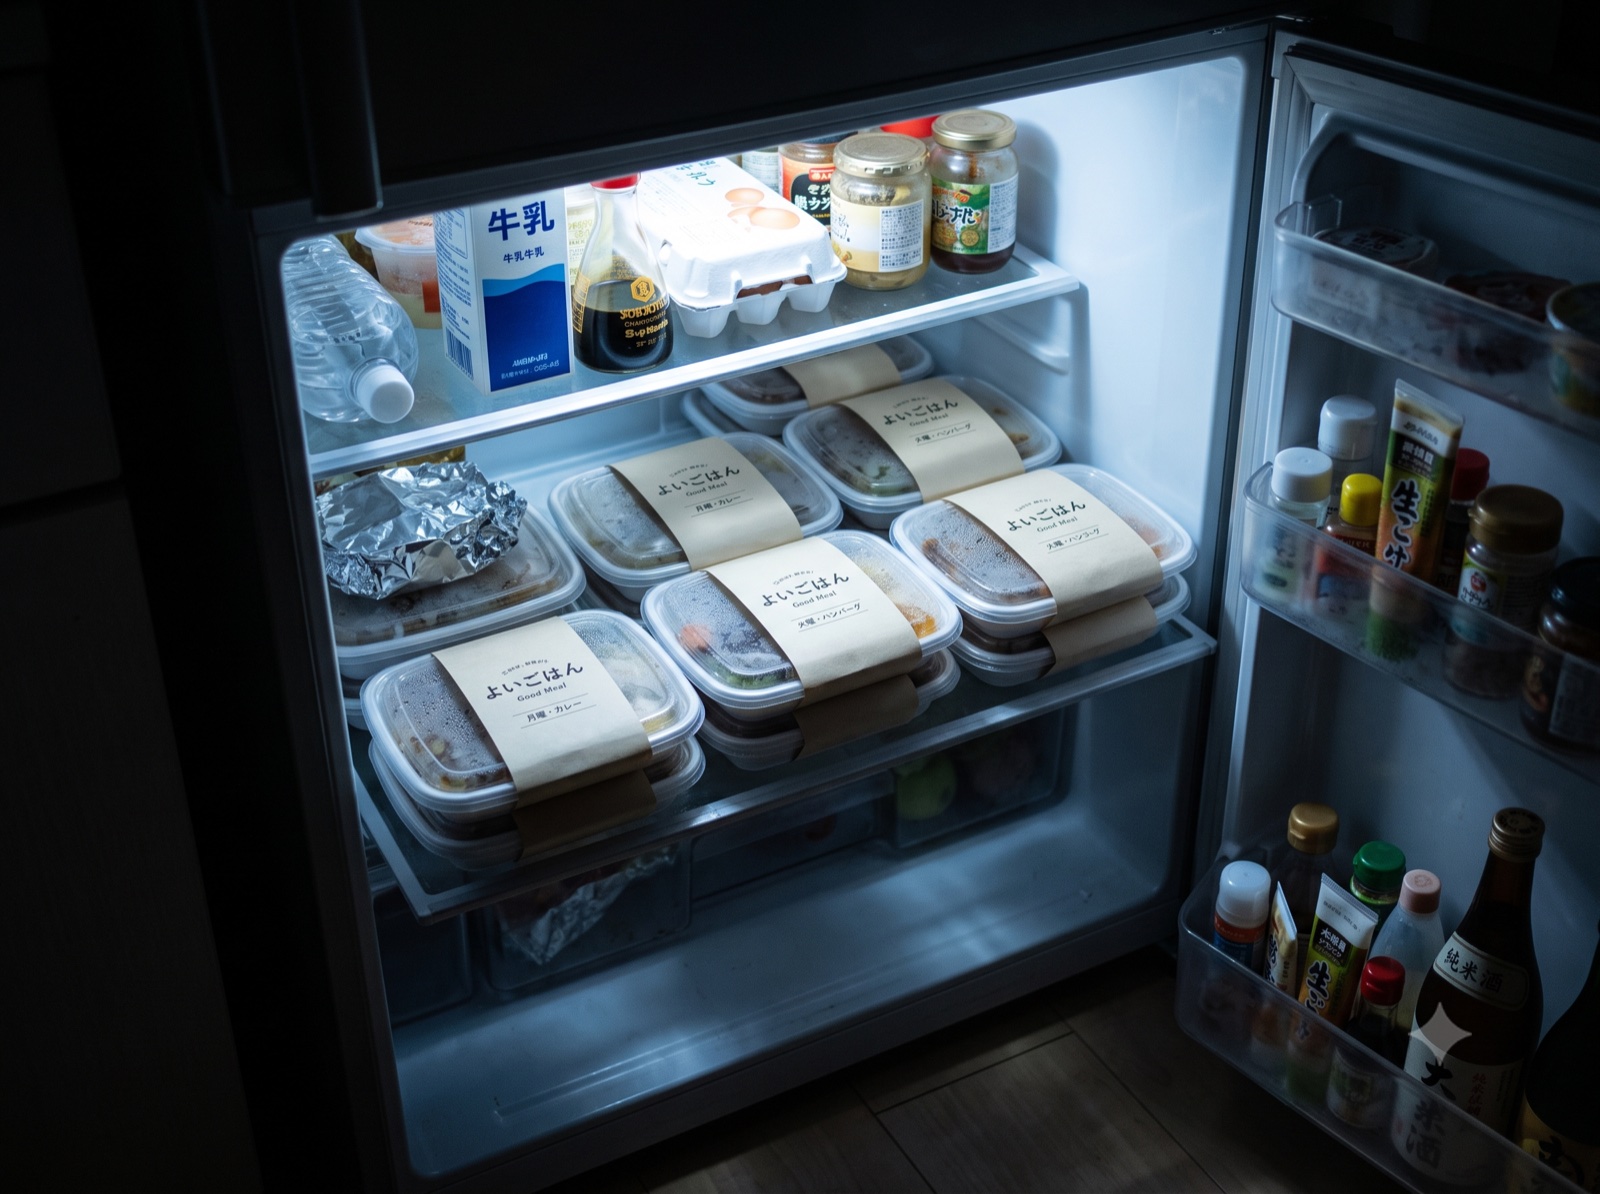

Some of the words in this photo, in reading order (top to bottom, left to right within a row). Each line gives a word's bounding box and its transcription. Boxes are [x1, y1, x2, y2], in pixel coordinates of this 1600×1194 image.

[488, 200, 555, 241] 牛乳
[792, 597, 815, 608] Good
[486, 662, 584, 700] よいごはん
[517, 691, 542, 702] Good
[544, 682, 567, 693] Meal
[527, 701, 582, 722] 月曜・カレー
[1444, 947, 1503, 993] 純米酒
